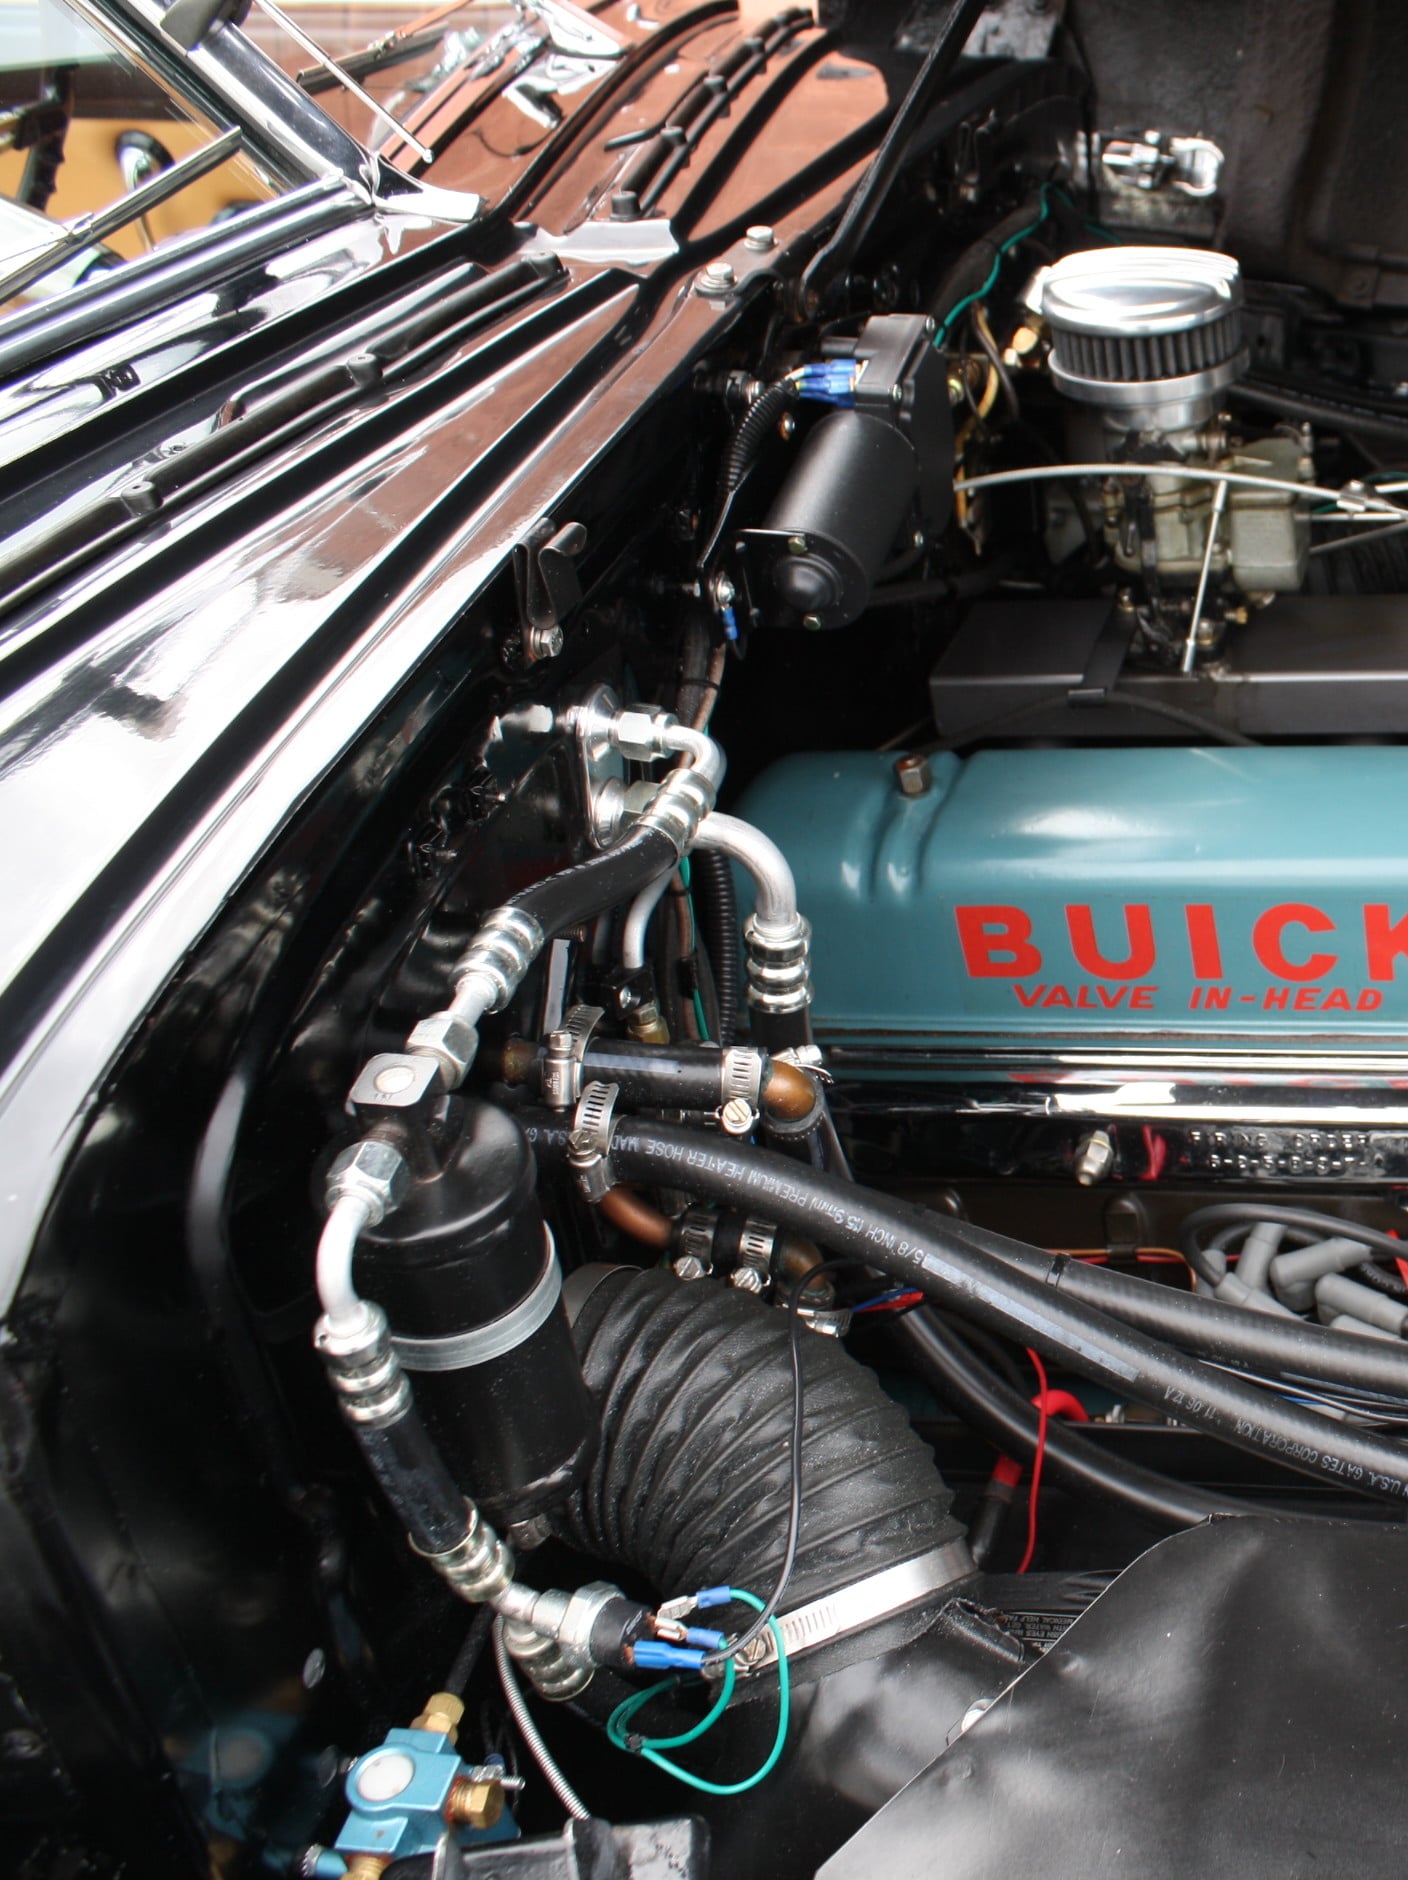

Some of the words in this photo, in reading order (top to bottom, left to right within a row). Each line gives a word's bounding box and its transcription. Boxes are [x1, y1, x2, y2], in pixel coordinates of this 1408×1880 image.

[1015, 986, 1156, 1008] VALVE
[1191, 988, 1381, 1010] IN-HEAD
[610, 1134, 640, 1151] MAD
[644, 1139, 683, 1160] HOSE
[685, 1149, 745, 1179] HEATER
[747, 1169, 809, 1205] PREMIUM
[866, 1223, 896, 1247] INCH
[897, 1240, 925, 1264] 5/8
[1233, 1419, 1319, 1463] CORPORATION
[1319, 1454, 1364, 1480] GATES
[1367, 1470, 1400, 1493] U.S.A.
